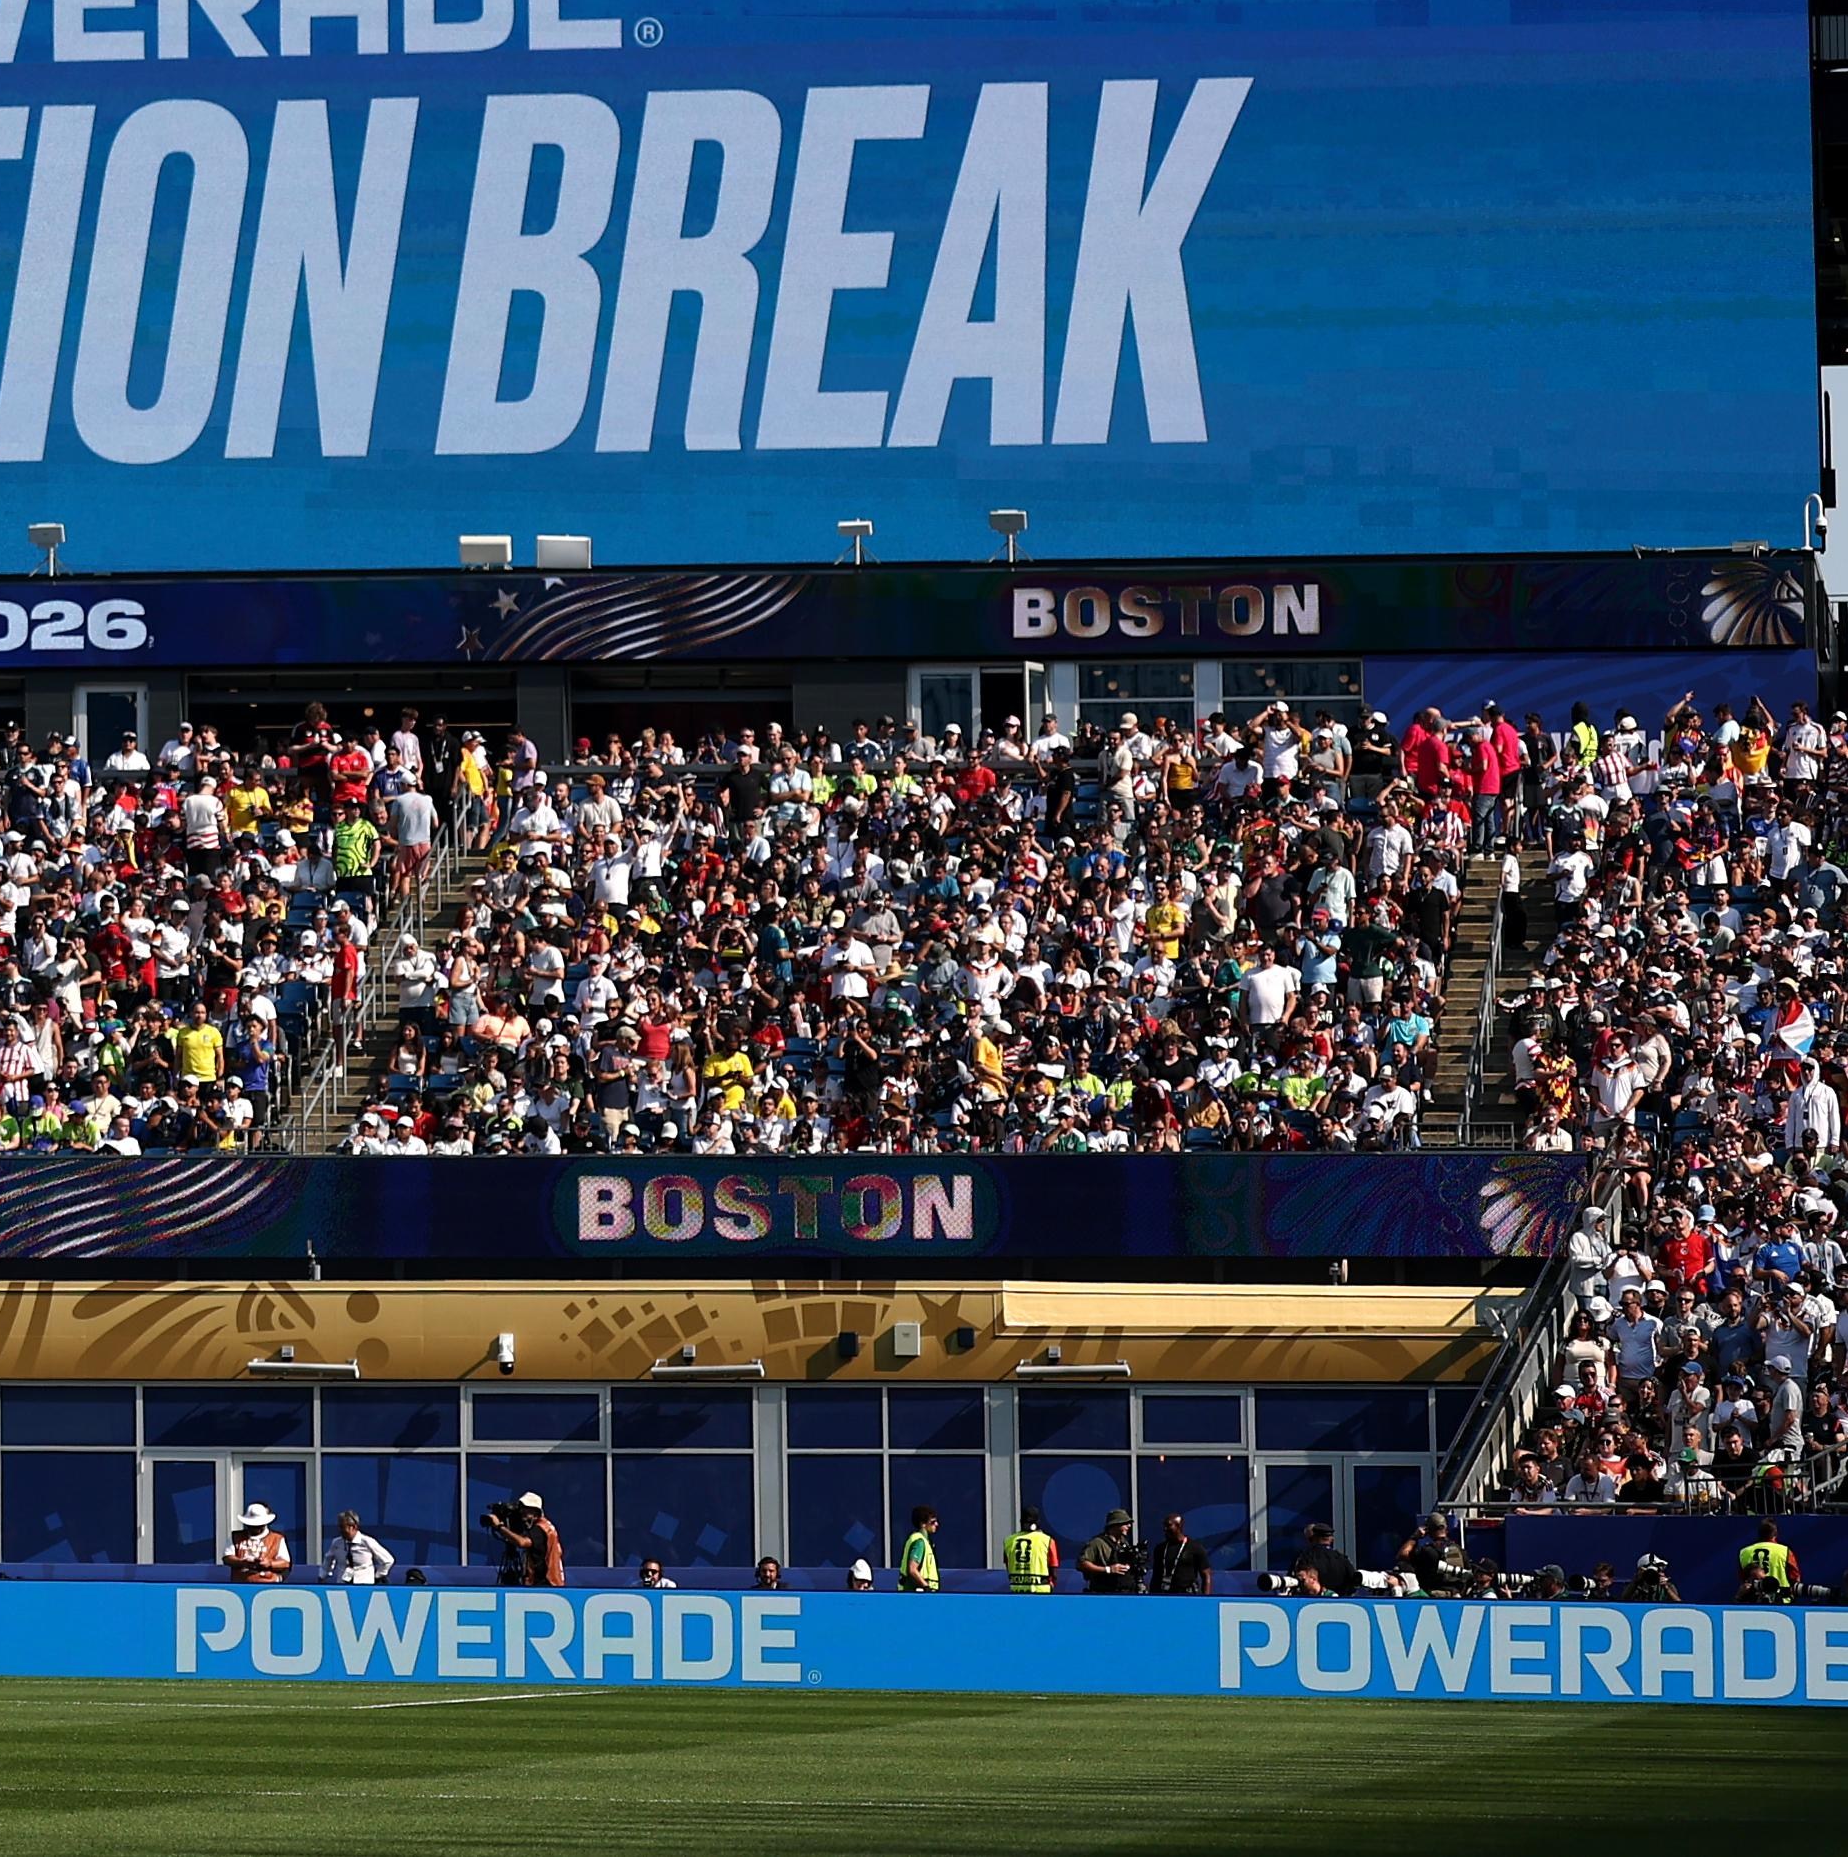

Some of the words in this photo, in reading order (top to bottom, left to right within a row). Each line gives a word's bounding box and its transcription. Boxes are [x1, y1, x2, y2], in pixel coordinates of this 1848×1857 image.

[433, 77, 1253, 456] BREAK
[1011, 583, 1320, 639] BOSTON
[577, 1174, 974, 1242] BOSTON
[175, 1587, 803, 1683] POWERADE
[1220, 1602, 1848, 1702] POWERADE
